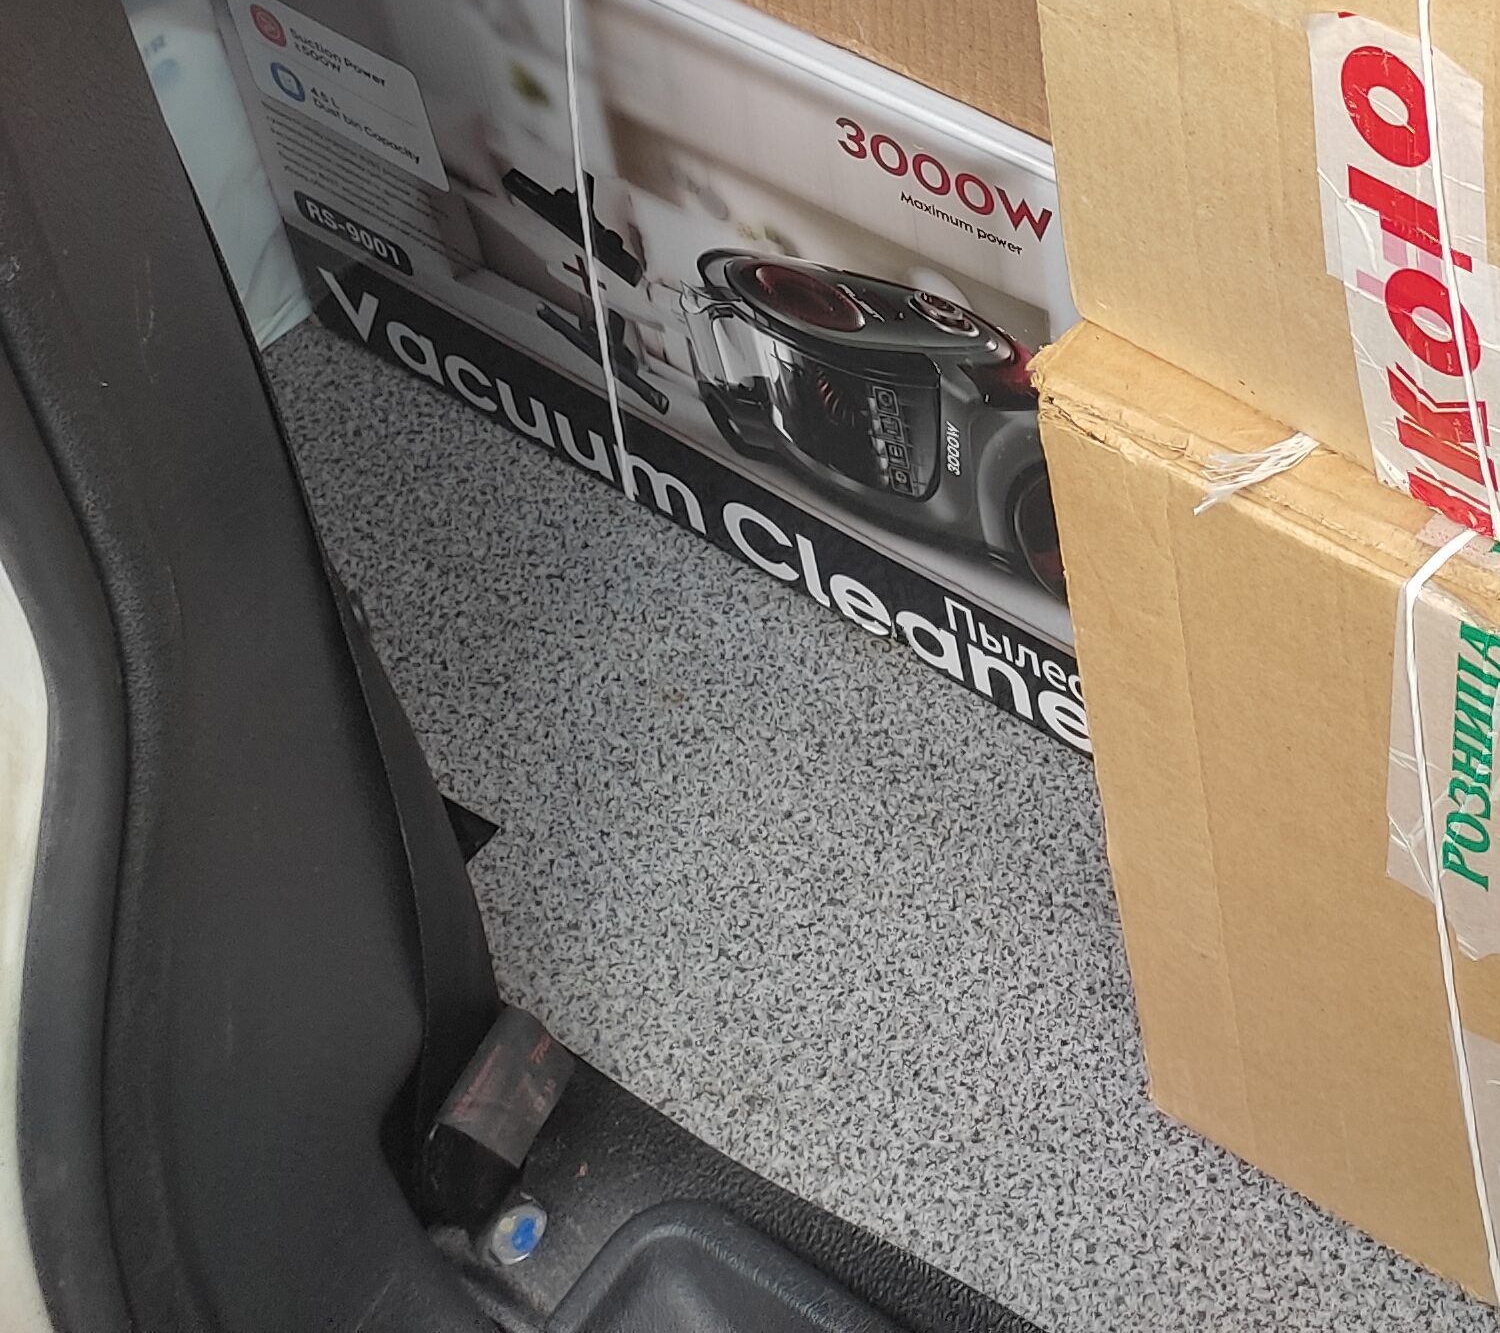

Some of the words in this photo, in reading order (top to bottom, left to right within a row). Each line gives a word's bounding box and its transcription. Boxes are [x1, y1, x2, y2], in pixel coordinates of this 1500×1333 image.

[835, 117, 1053, 243] 3000W
[304, 199, 401, 266] RS-9001
[900, 191, 974, 235] Maximum
[976, 227, 1024, 256] power
[317, 266, 707, 535] Vacuum
[945, 420, 961, 477] 3000W
